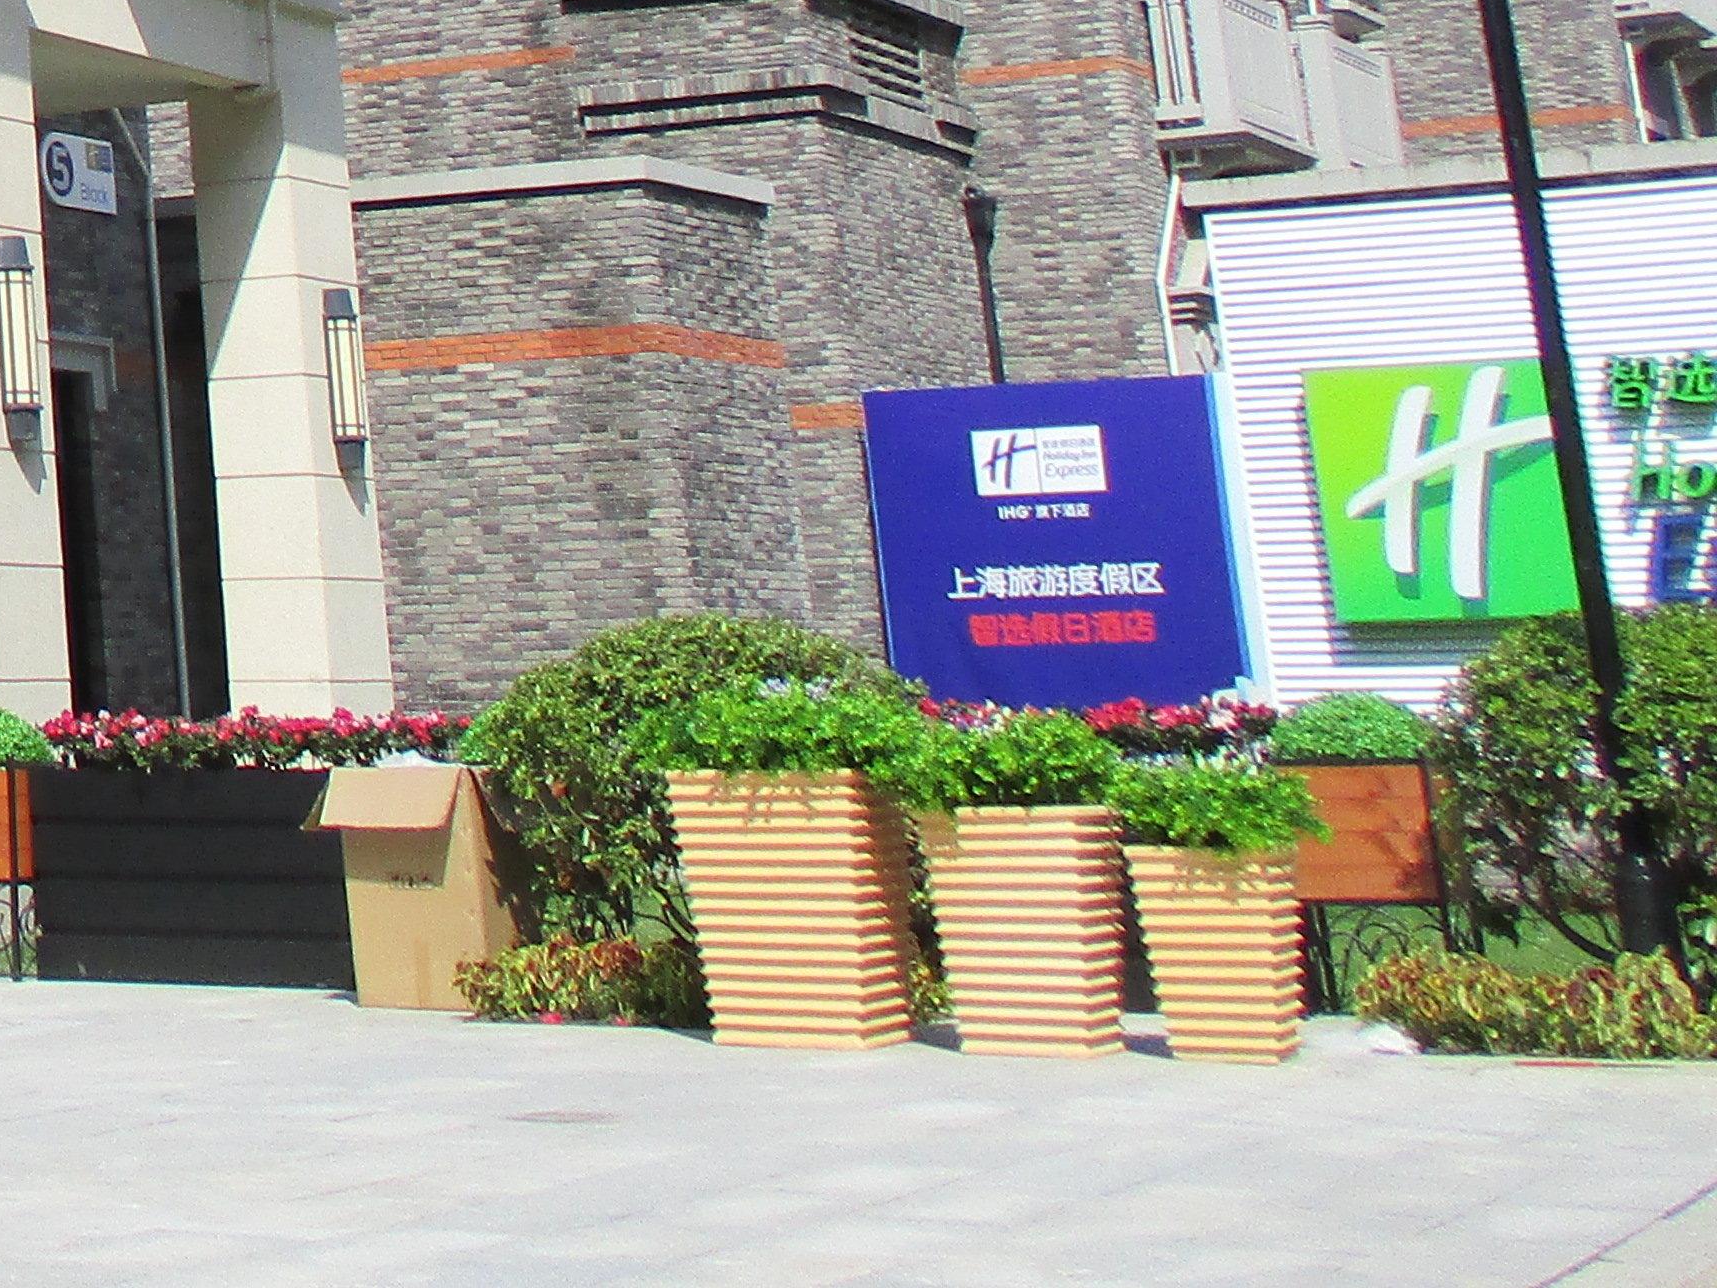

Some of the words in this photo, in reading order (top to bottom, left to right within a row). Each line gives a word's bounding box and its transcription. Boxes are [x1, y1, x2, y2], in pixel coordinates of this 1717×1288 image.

[51, 144, 71, 191] 5
[1045, 462, 1099, 480] Express
[947, 562, 1164, 598] 上海旅游度假区
[970, 611, 1156, 646] 智选假日酒店
